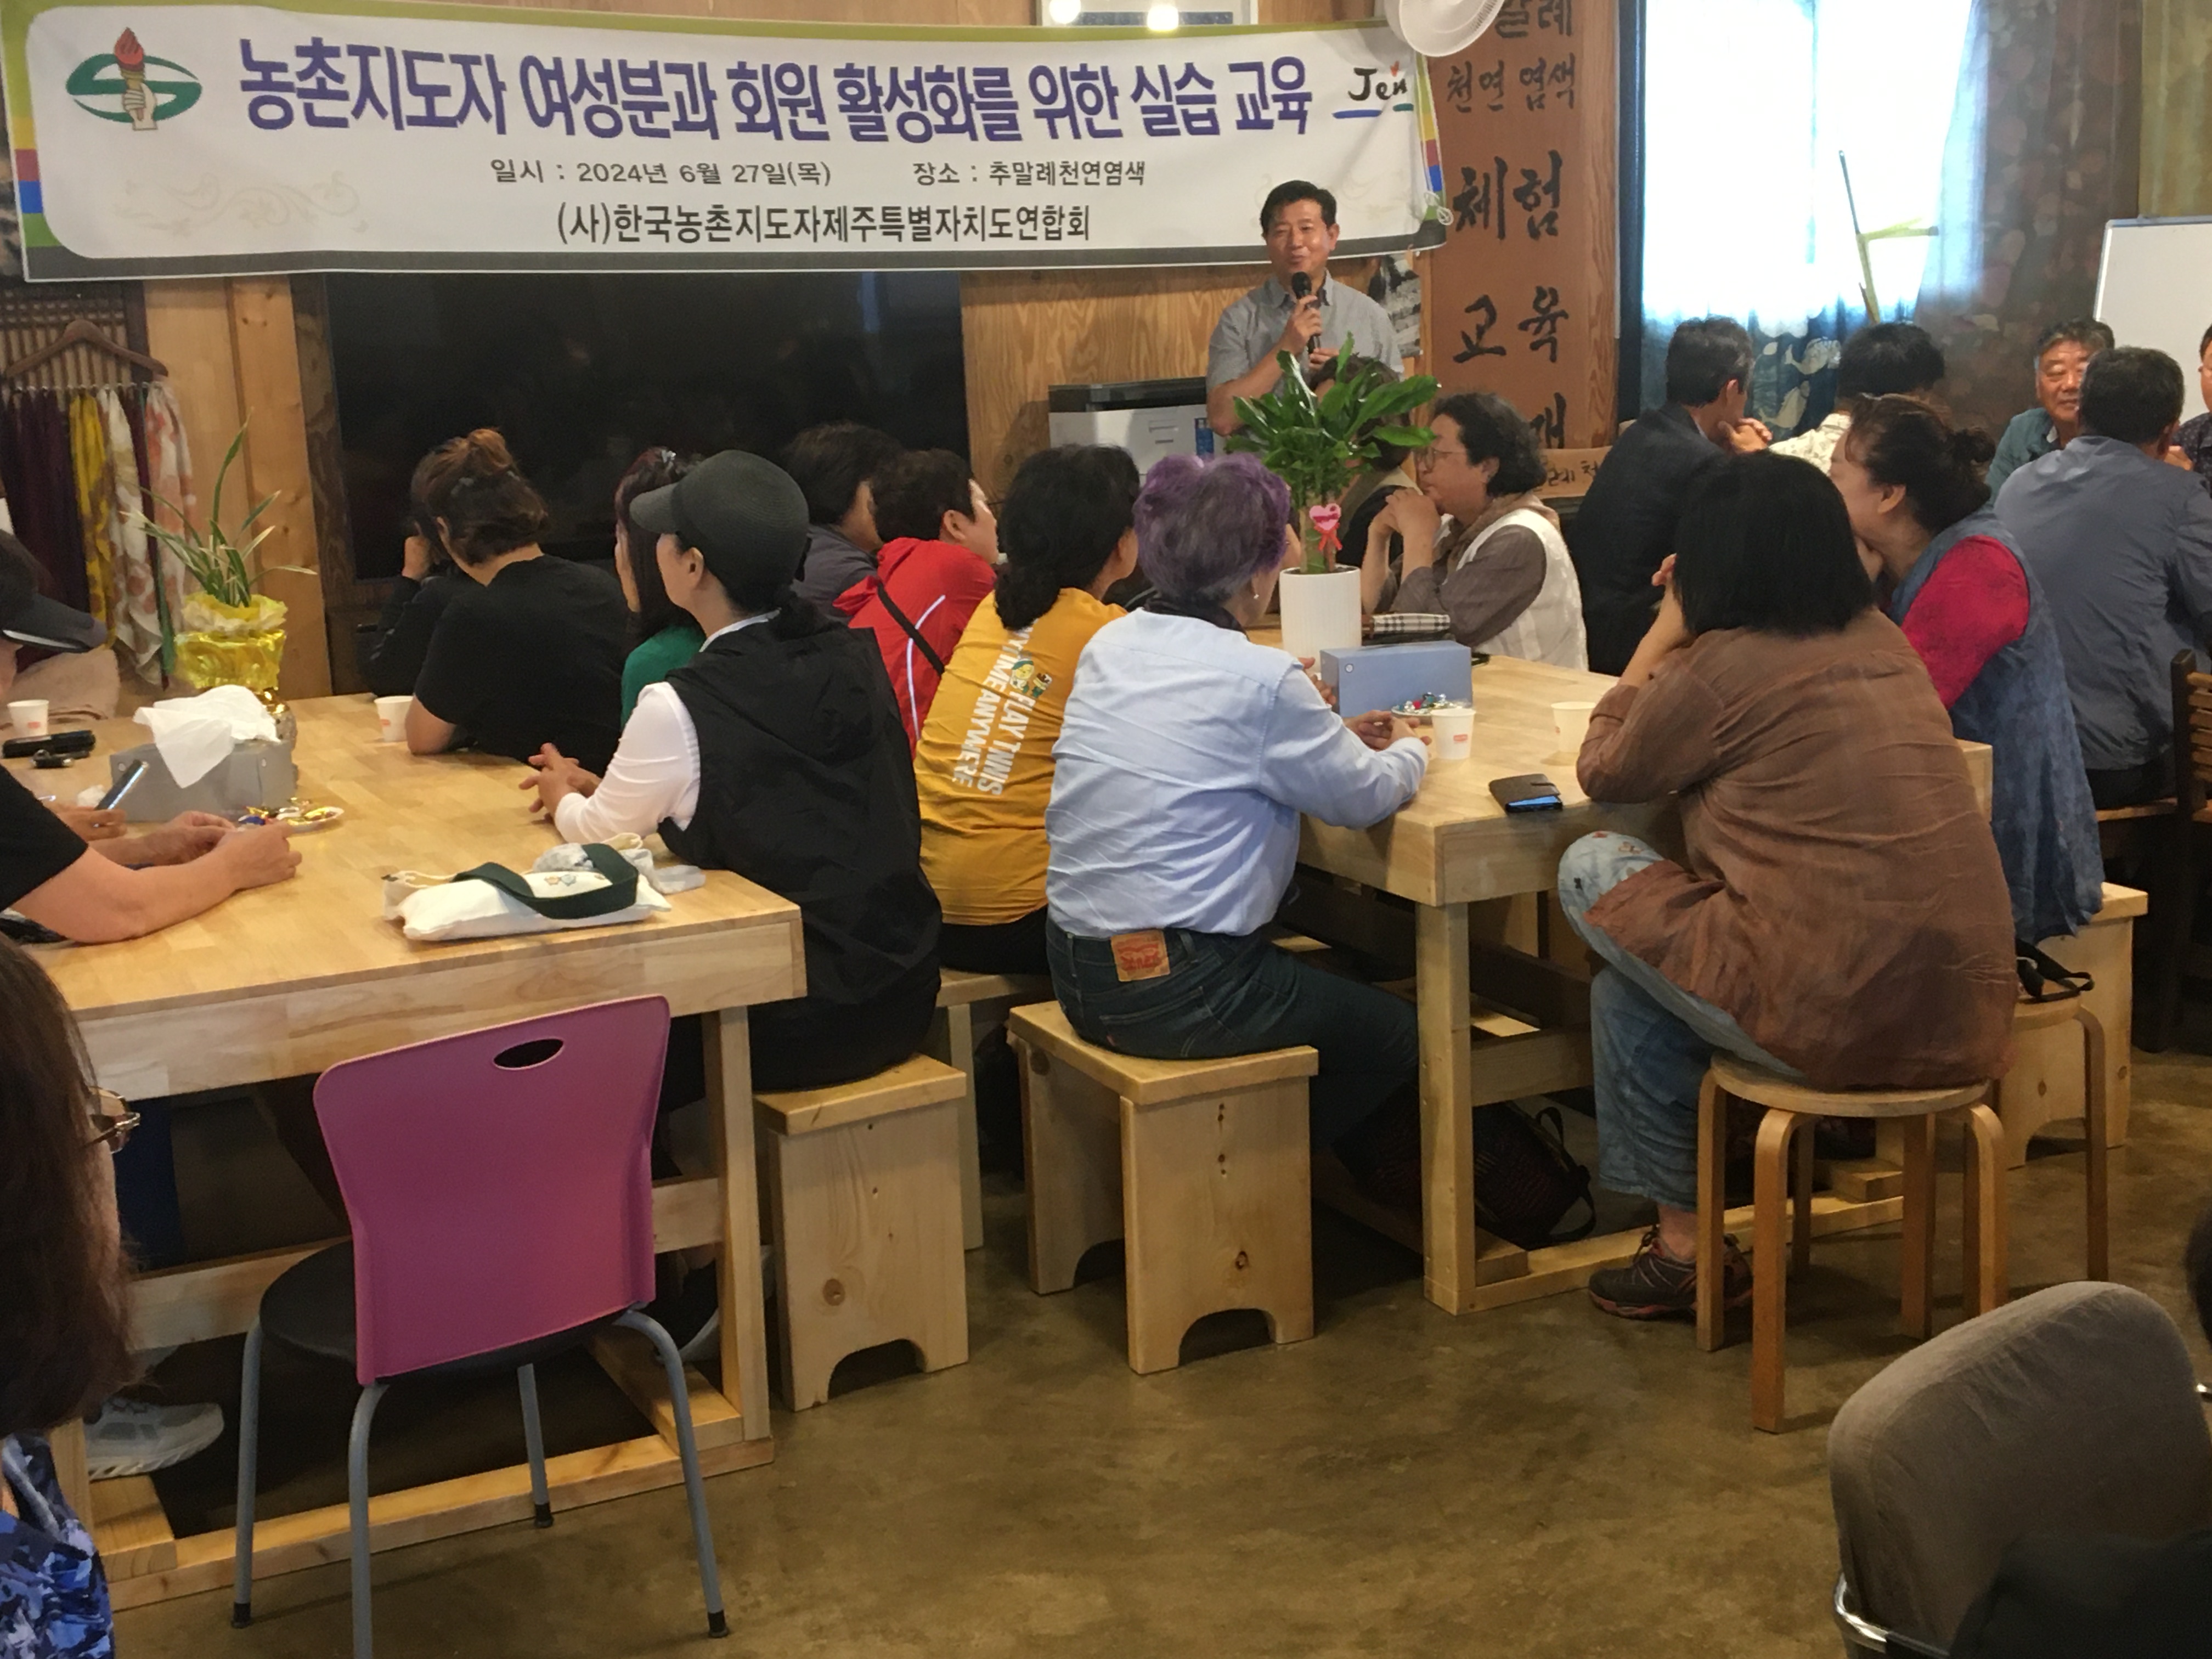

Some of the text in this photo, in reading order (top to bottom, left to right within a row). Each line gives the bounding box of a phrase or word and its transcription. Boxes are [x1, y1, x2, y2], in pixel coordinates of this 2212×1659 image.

[239, 36, 1313, 144] 농촌지도자 여성분과 회원 활성화를 위한 실습 교육
[1447, 53, 1576, 113] 천연 염색
[490, 159, 544, 183] 일시
[577, 162, 669, 184] 2024년
[679, 162, 722, 185] 6월
[731, 161, 831, 187] 27일(목)
[913, 161, 960, 186] 장소
[989, 160, 1146, 187] 추말례천연염색
[1453, 149, 1562, 240] 체험
[557, 201, 1090, 245] (사)한국농촌지도자제주특별자치도연합회
